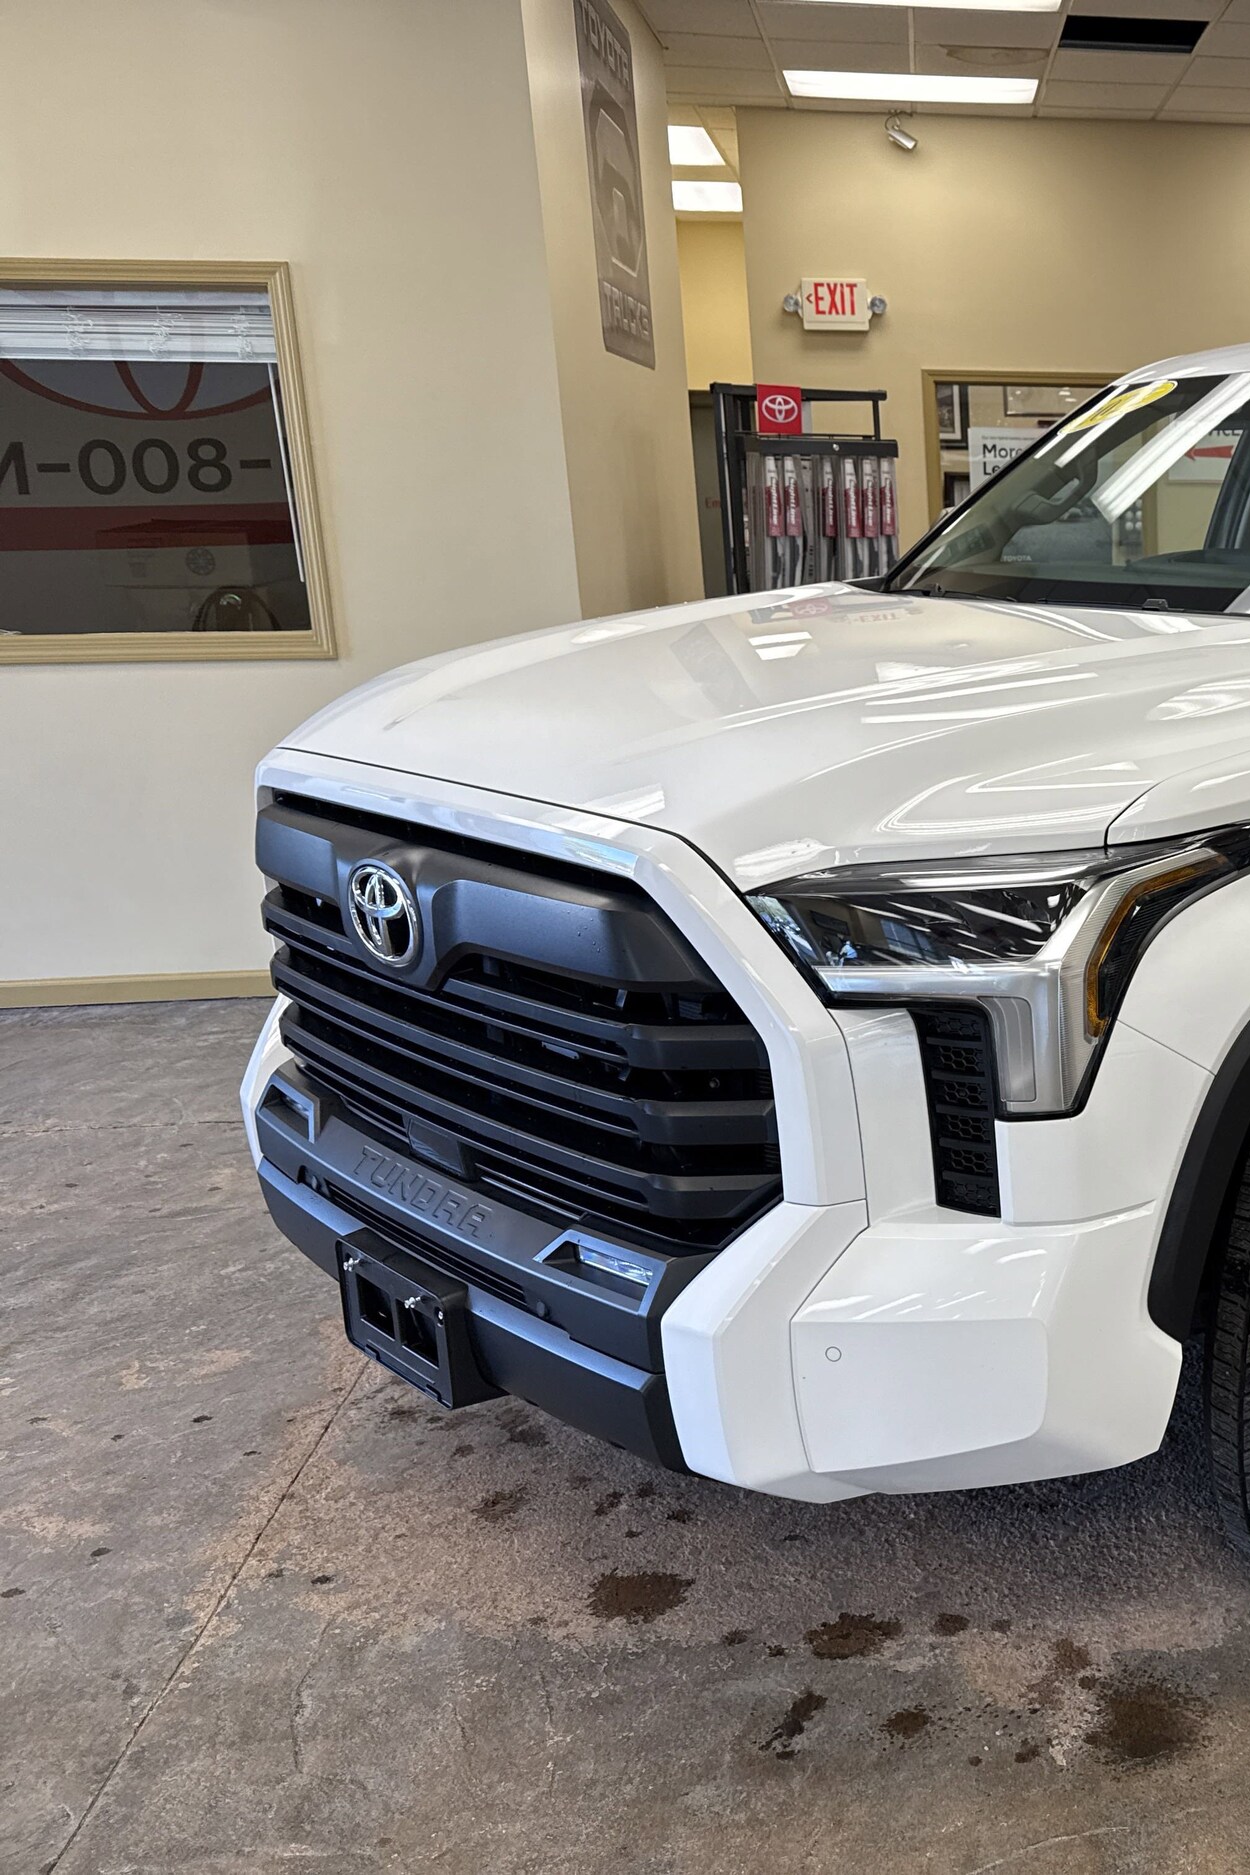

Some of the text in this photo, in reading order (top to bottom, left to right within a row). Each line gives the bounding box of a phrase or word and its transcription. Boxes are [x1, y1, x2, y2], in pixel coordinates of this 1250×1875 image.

[602, 280, 650, 341] TRUCKS
[813, 282, 857, 316] EXIT
[353, 1145, 494, 1239] TUNDRA
